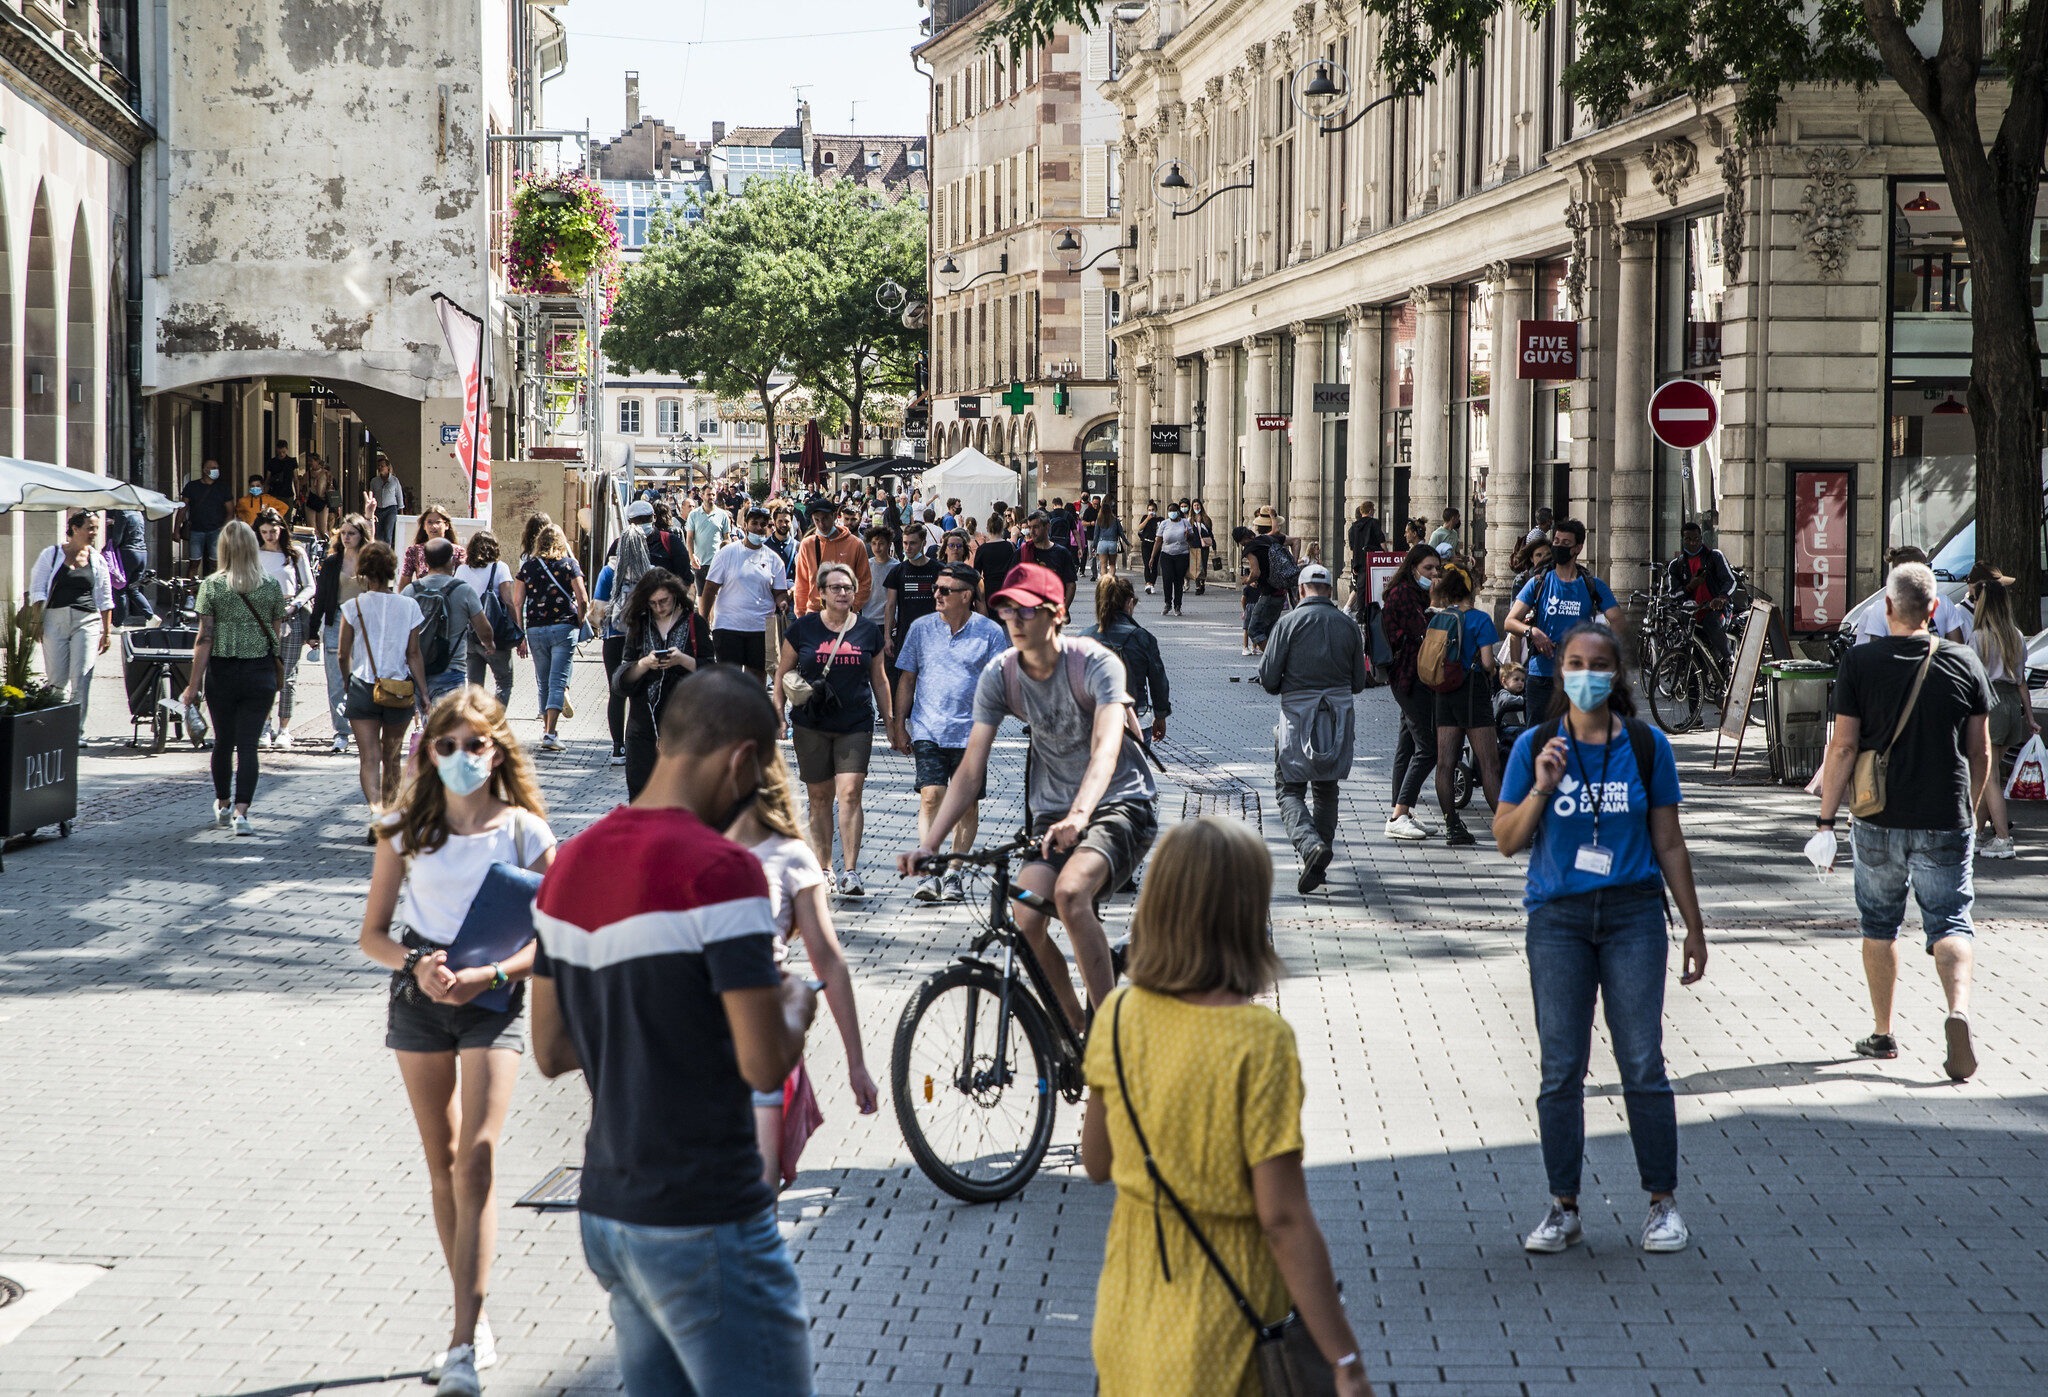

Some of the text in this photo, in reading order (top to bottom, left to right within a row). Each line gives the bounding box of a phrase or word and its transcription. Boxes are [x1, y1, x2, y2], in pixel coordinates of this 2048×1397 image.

[1529, 336, 1568, 349] FIVE
[1524, 350, 1573, 364] GUYS
[1153, 431, 1178, 440] NYX
[1813, 482, 1828, 549] FIVE
[1372, 556, 1392, 564] FIVE
[1813, 556, 1829, 625] GUYS
[816, 654, 860, 665] SÜTIROL
[25, 749, 65, 791] PAUL
[1580, 802, 1594, 813] LA
